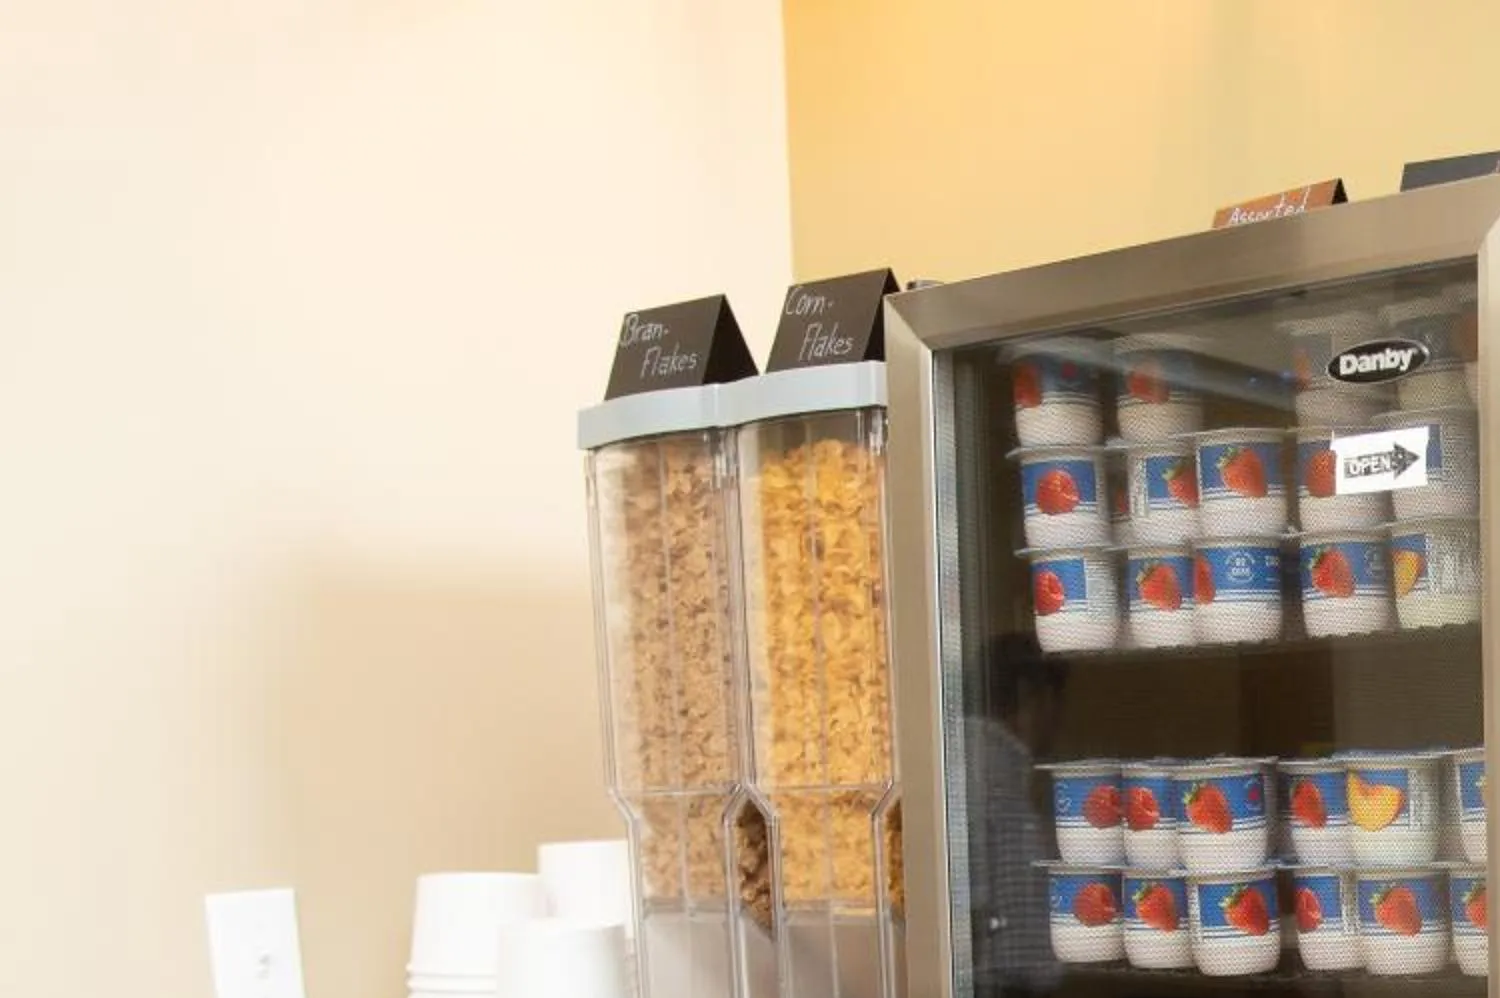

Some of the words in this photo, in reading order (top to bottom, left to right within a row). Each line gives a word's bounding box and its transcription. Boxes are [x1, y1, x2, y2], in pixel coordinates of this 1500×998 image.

[798, 322, 855, 361] Flakes
[640, 341, 698, 378] Flakes
[1339, 347, 1419, 376] Danby
[1348, 454, 1393, 476] OPEN
